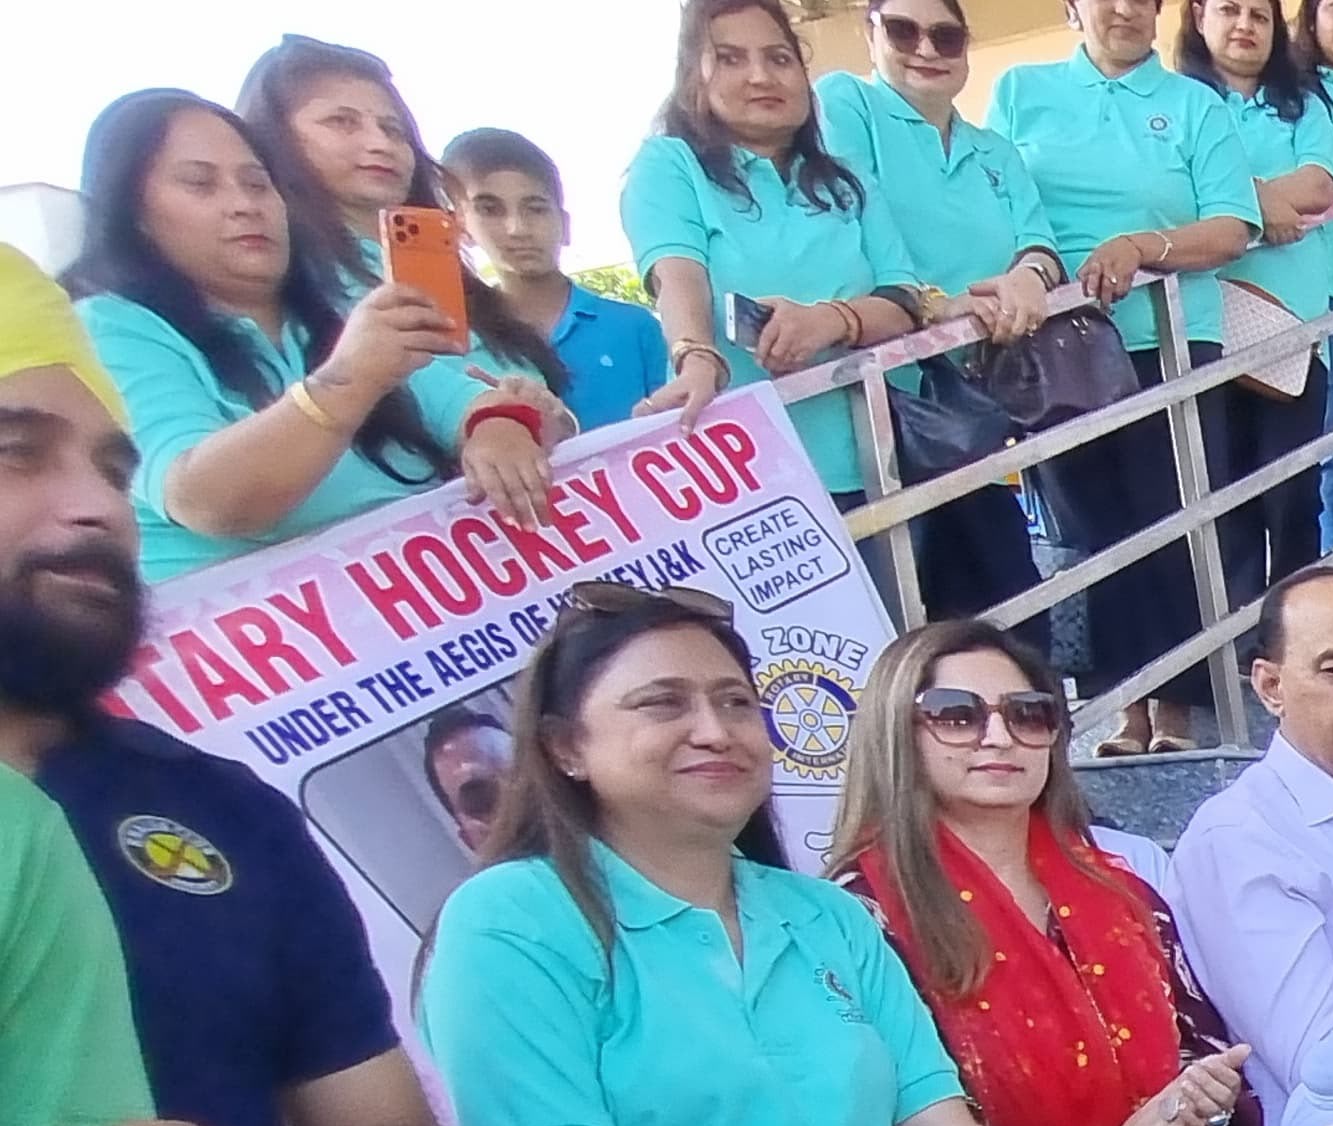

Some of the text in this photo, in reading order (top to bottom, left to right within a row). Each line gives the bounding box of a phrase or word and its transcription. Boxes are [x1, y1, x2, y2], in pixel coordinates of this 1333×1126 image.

[714, 508, 799, 556] CREATE
[732, 528, 822, 581] LASTING
[103, 582, 358, 735] TARY
[632, 422, 761, 521] CUP
[750, 556, 826, 606] IMPACT
[245, 690, 373, 766] UNDER
[356, 667, 434, 714] THE
[424, 622, 517, 688] AEGIS
[510, 602, 550, 648] OF
[646, 540, 706, 591] J&K
[761, 625, 869, 670] ZONE
[764, 673, 809, 700] ROTARY
